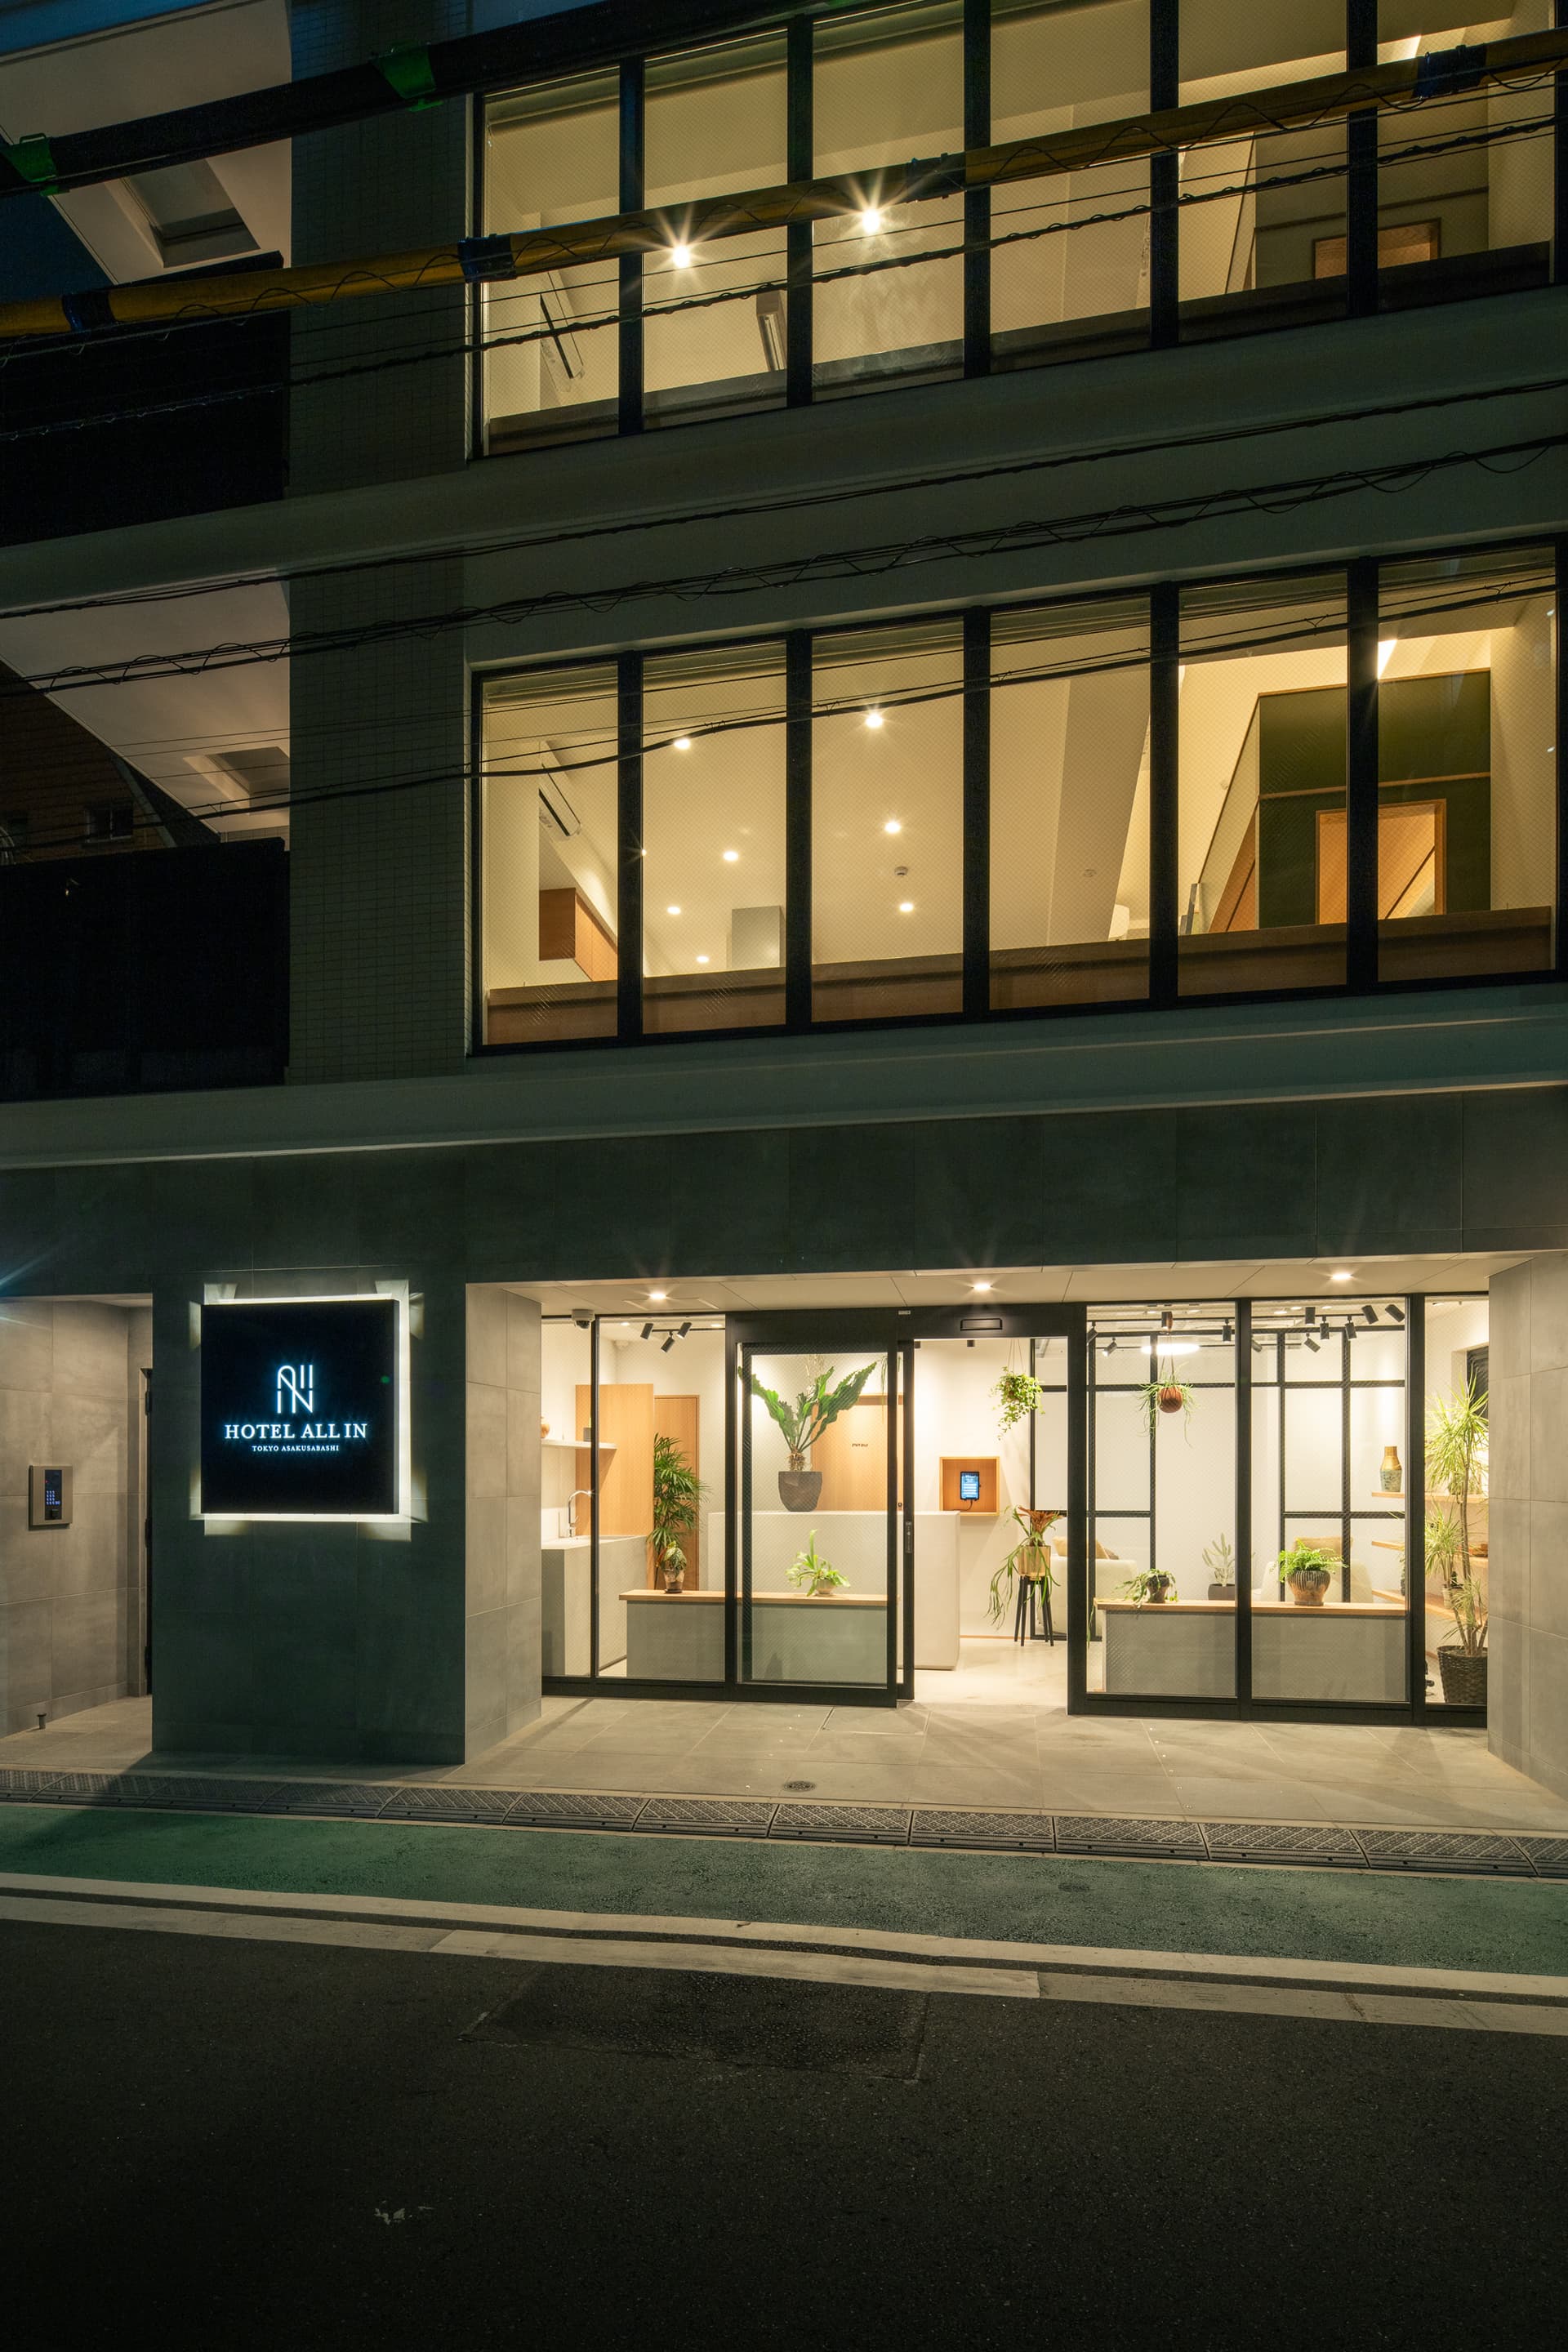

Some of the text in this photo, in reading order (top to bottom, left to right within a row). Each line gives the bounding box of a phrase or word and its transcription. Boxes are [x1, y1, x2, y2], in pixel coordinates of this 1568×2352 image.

[224, 1423, 368, 1440] HOTEL ALL IN
